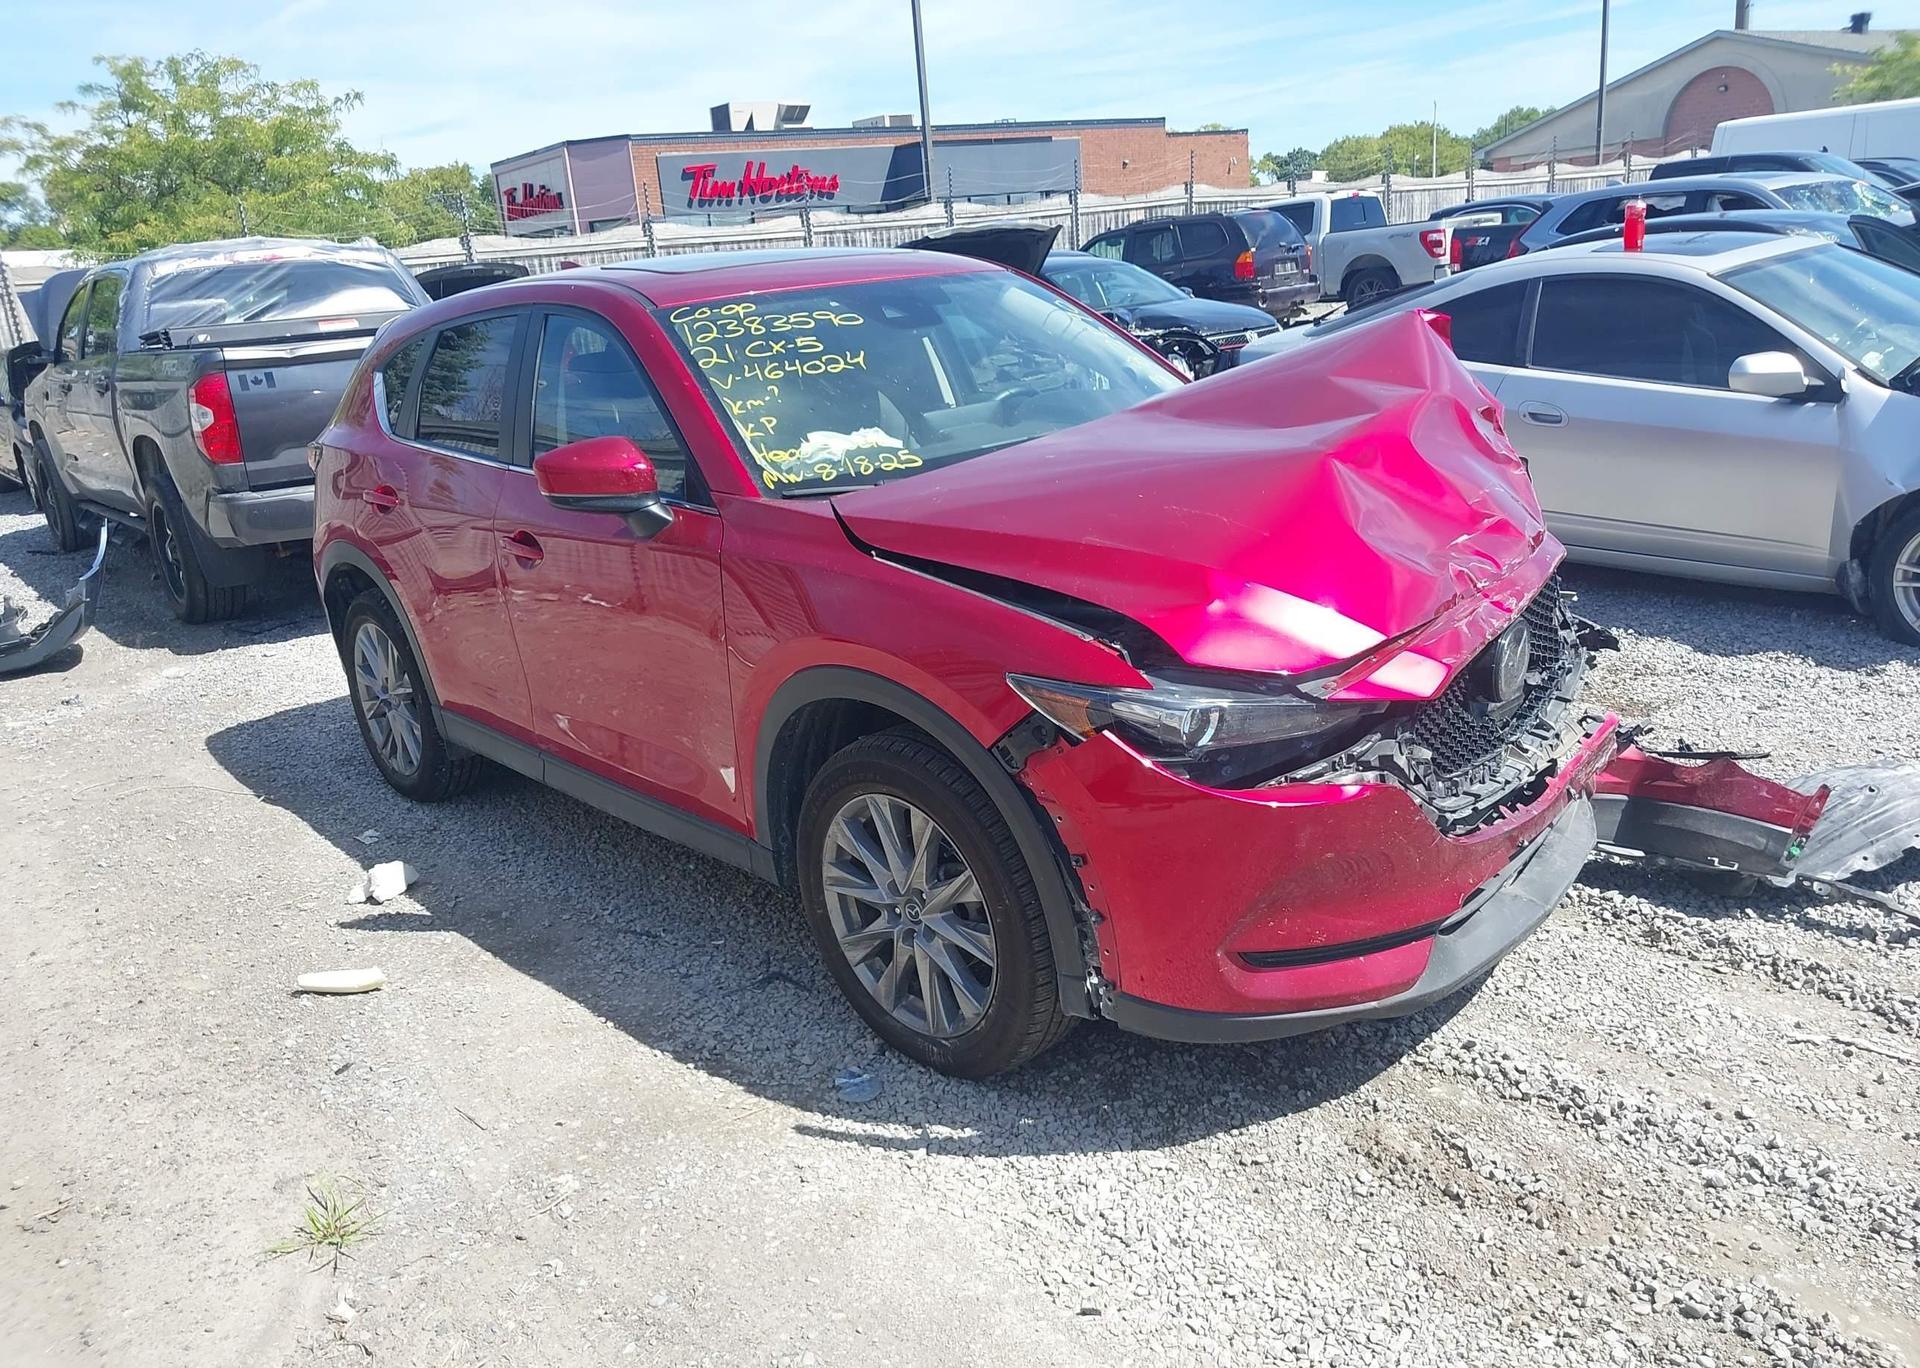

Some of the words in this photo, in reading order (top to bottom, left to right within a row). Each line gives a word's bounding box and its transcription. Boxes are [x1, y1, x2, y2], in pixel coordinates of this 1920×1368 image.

[683, 163, 737, 199] Tim
[741, 160, 840, 197] Hortons
[682, 311, 864, 347] 12383590
[690, 343, 734, 369] 21
